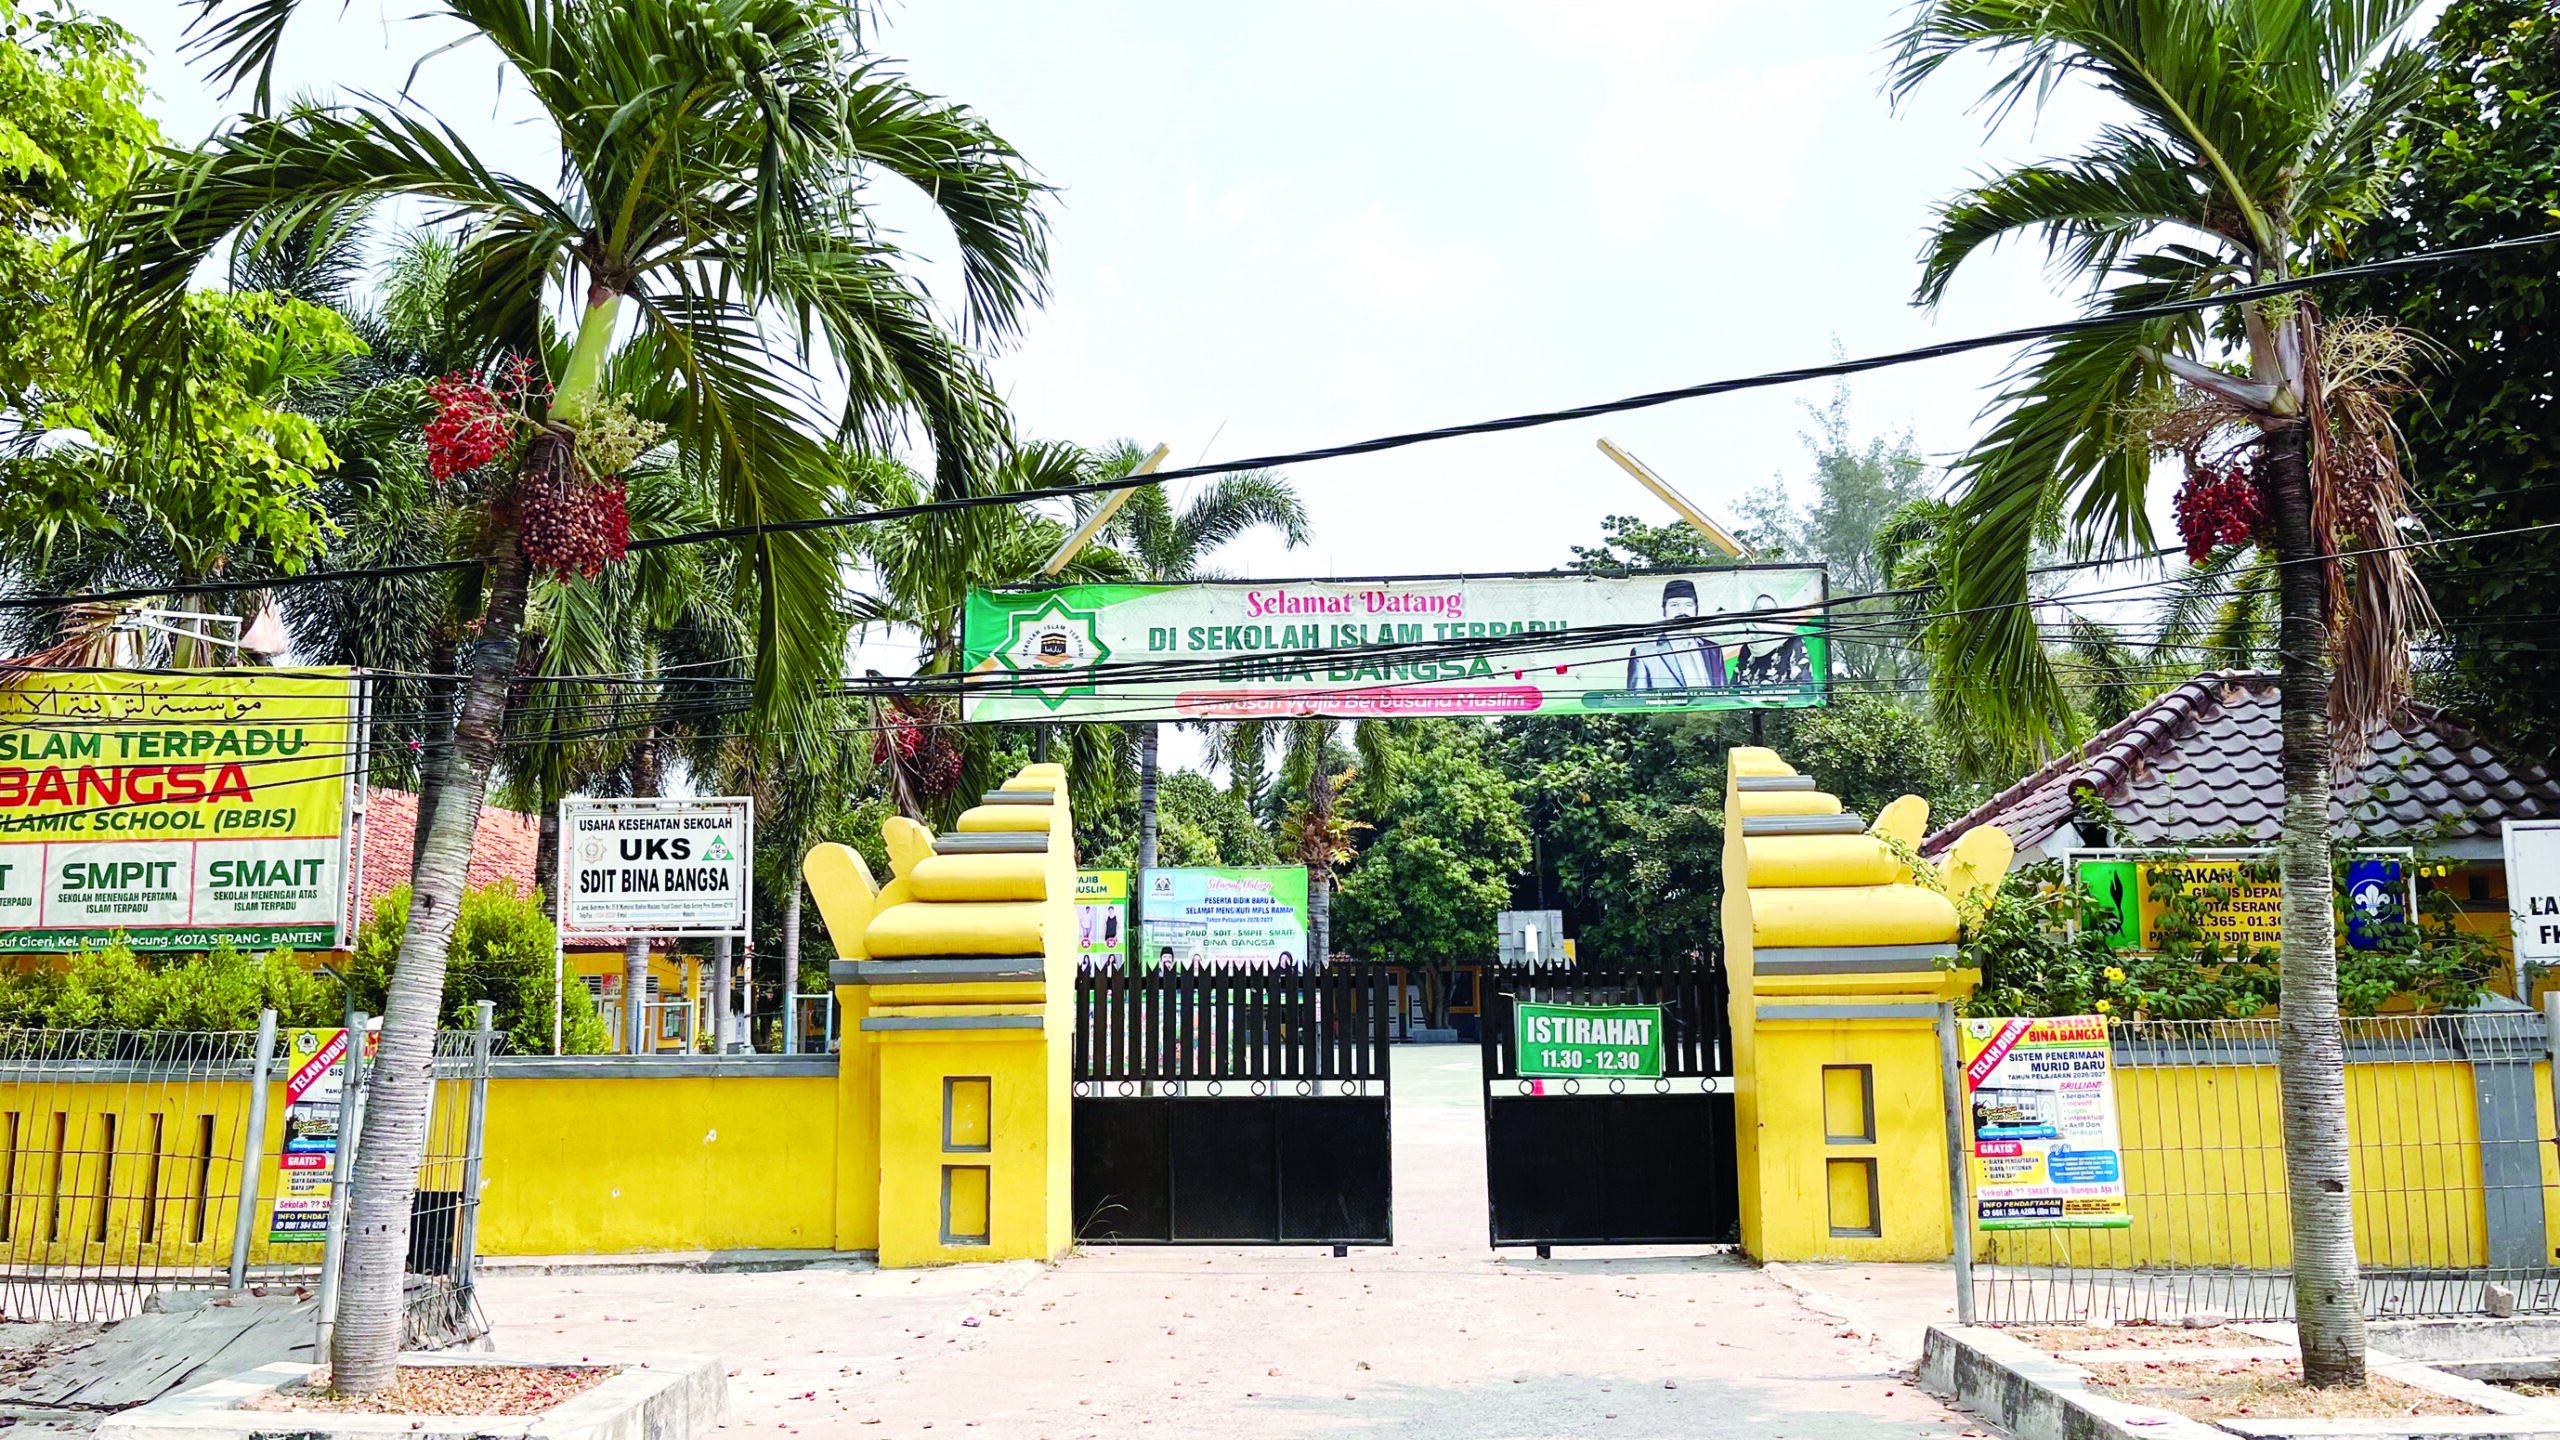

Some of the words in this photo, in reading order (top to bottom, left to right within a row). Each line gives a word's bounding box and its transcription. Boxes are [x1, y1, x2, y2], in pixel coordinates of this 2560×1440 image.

[1247, 590, 1354, 618] Selamat
[1360, 590, 1463, 618] Datang
[1148, 627, 1177, 651] DI
[1188, 624, 1320, 651] SEKOLAH
[1331, 622, 1423, 649] ISLAM
[1328, 654, 1496, 682] BANGSA
[1345, 693, 1453, 709] Berbusana
[1457, 692, 1525, 707] Muslim
[114, 728, 303, 759] TERPADU
[0, 763, 254, 807] BANGSA
[0, 811, 87, 833] LAMIC
[93, 810, 206, 831] SCHOOL
[213, 807, 297, 834] (BBIS)
[579, 819, 616, 831] USAHA
[618, 818, 680, 831] KESEHATAN
[683, 818, 733, 830] SEKOLAH
[620, 837, 691, 861] UKS
[62, 861, 178, 890] SMPIT
[209, 859, 325, 888] SMAIT
[1077, 875, 1099, 884] AJIB
[580, 868, 617, 894] SDIT
[621, 868, 660, 893] BINA
[664, 867, 730, 892] BANGSA
[213, 890, 249, 901] SEKOLAH
[251, 890, 297, 900] MENENGAH
[299, 889, 318, 899] ATAS
[1076, 886, 1108, 894] USLIM
[58, 893, 93, 903] SEKOLAH
[95, 892, 139, 902] MENENGAH
[141, 892, 178, 901] PERTAMA
[1204, 896, 1232, 905] PESERTA
[1252, 896, 1269, 904] BARU
[86, 904, 111, 914] ISLAM
[113, 903, 149, 913] TERPADU
[234, 902, 259, 912] ISLAM
[261, 901, 297, 911] TERPADU
[1186, 907, 1215, 915] SELAMAT
[1216, 906, 1251, 914] MENGIKUTI
[2204, 902, 2230, 912] OTA
[2530, 896, 2560, 915] LA
[1185, 929, 1208, 937] PAUD
[1213, 929, 1232, 937] SDIT
[2223, 931, 2251, 942] SDIT
[2253, 931, 2282, 942] BINA
[20, 935, 55, 949] Ciceri,
[57, 936, 79, 947] Kel.
[174, 934, 208, 945] KOTA
[271, 932, 322, 944] BANTEN
[1203, 939, 1228, 947] BINA
[1231, 939, 1276, 947] BANGSA
[1527, 1016, 1653, 1046] ISTIRAHAT
[2028, 1030, 2058, 1042] BINA
[2060, 1028, 2105, 1041] BANGSA
[288, 1060, 324, 1094] TELAH
[319, 1032, 349, 1066] DIBUK
[1541, 1049, 1583, 1068] 11.30
[1595, 1050, 1640, 1070] 12.30
[1968, 1045, 2002, 1080] TELAH
[2008, 1052, 2043, 1062] SISTEM
[2045, 1051, 2105, 1061] PENERIMAAN
[2031, 1062, 2070, 1072] MURID
[2074, 1060, 2105, 1071] BARU
[2031, 1072, 2072, 1080] PELAJARAN
[1981, 1189, 2014, 1197] Sekolah
[2071, 1186, 2099, 1196] Bangsa
[280, 1200, 308, 1209] Sekolah
[1982, 1201, 2003, 1209] INFO
[2003, 1199, 2061, 1207] PENDAFTARAN
